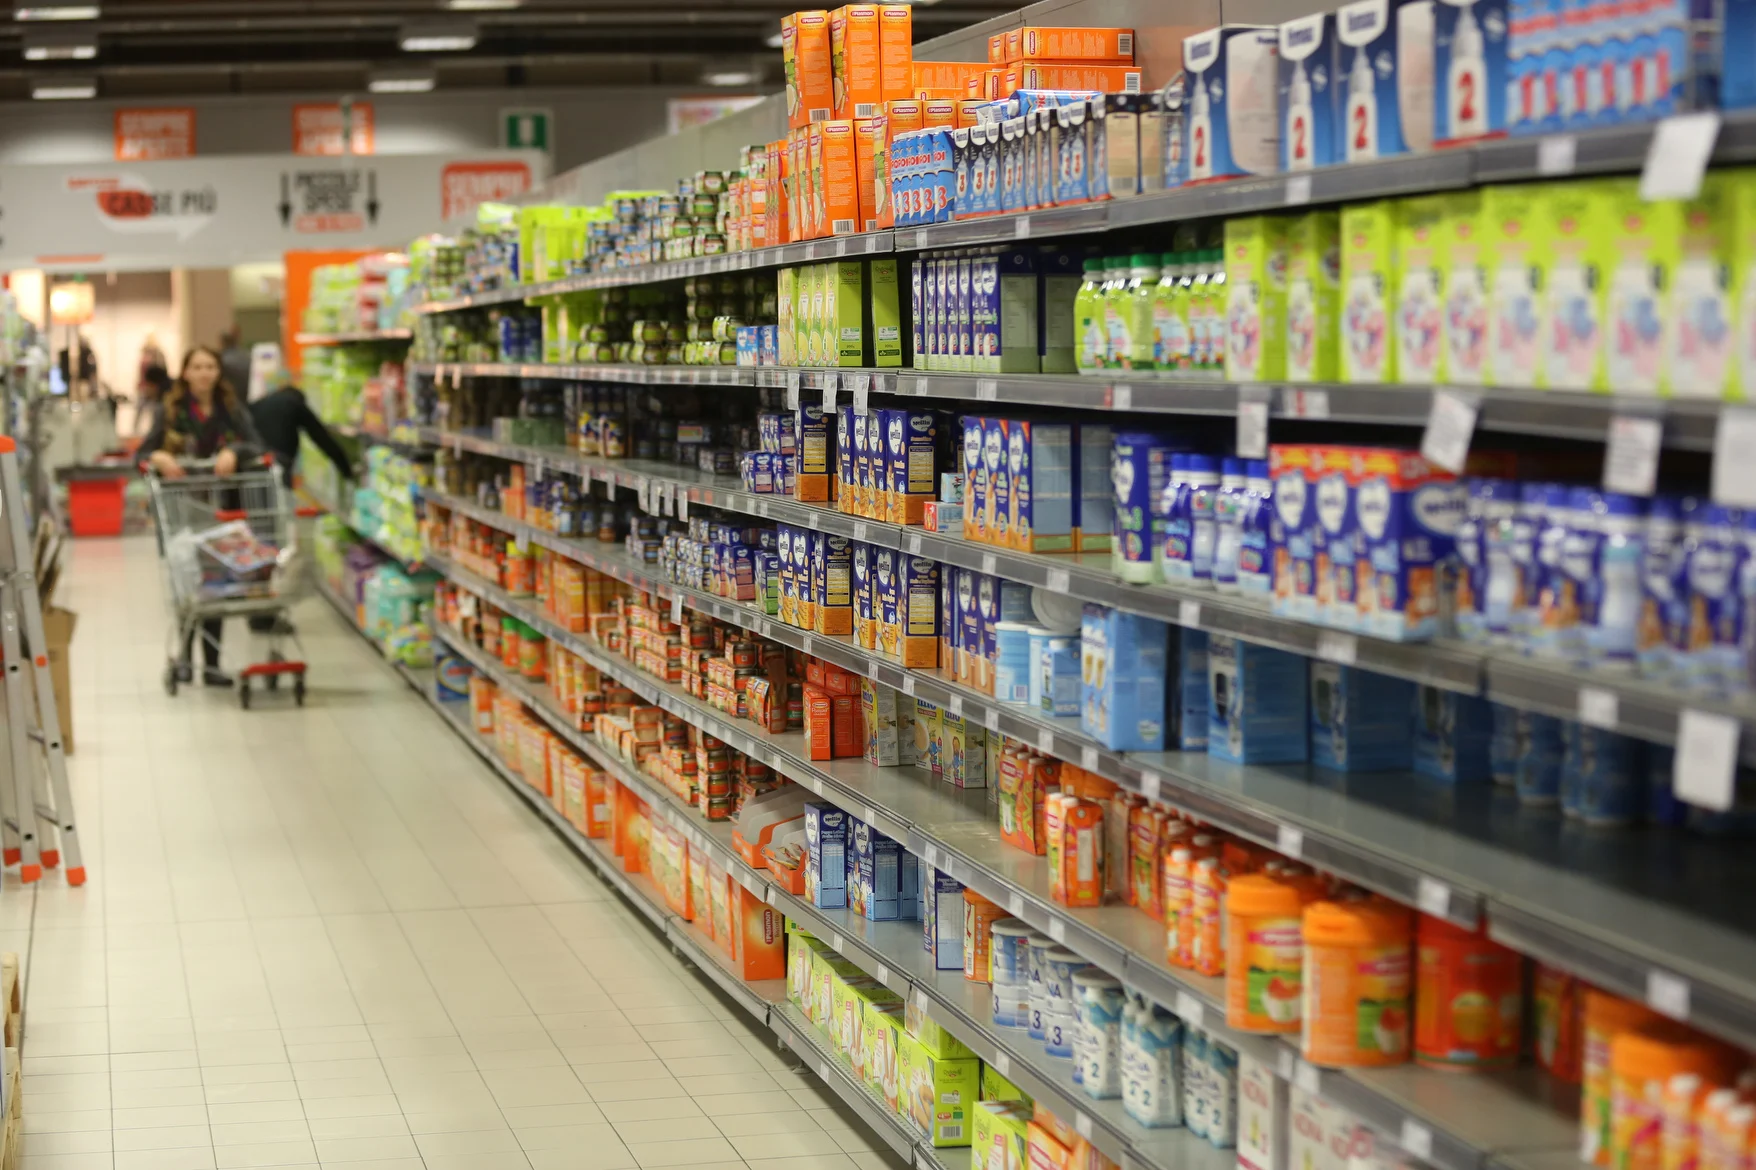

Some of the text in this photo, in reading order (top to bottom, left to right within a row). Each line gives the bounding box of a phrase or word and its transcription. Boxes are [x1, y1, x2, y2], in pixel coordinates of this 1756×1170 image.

[1458, 71, 1475, 121] 2
[1294, 115, 1306, 160] 2
[1354, 104, 1368, 150] 2
[1194, 126, 1205, 167] 2
[912, 190, 920, 212] 3
[924, 188, 933, 211] 3
[938, 186, 947, 209] 3
[1033, 1010, 1041, 1029] 3
[1052, 1026, 1062, 1046] 3
[1091, 1063, 1099, 1078] 2
[1143, 1089, 1150, 1106] 2
[1213, 1109, 1221, 1125] 2
